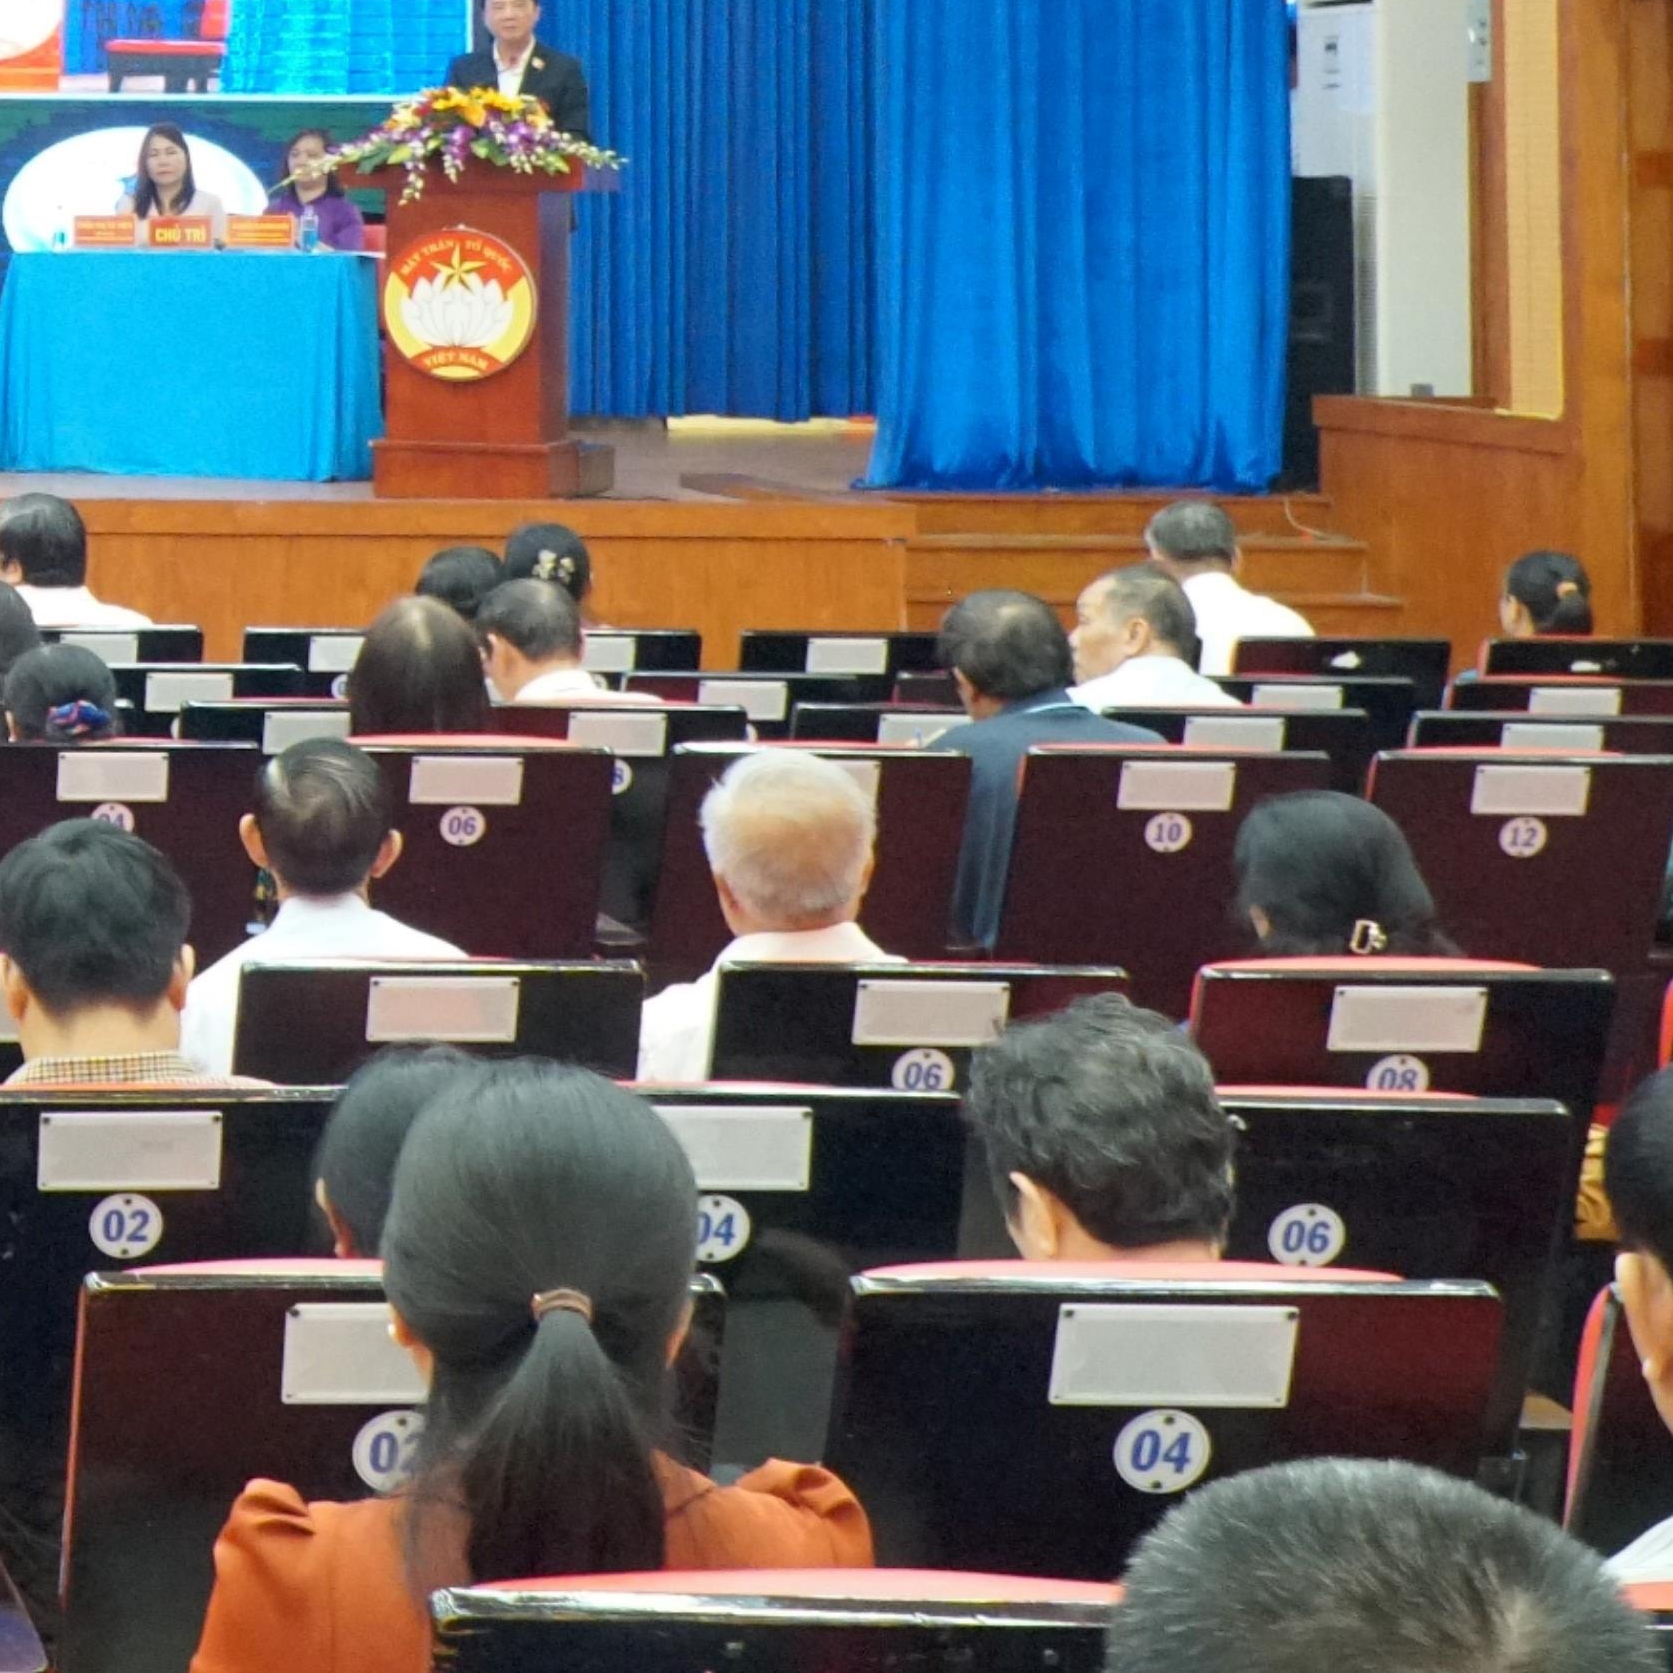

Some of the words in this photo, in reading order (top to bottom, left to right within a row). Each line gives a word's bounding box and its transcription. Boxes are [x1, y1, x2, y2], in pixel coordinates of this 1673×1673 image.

[155, 223, 181, 243] CHỦ
[184, 225, 207, 243] TRÌ
[447, 814, 477, 837] 06
[1152, 821, 1184, 844] 10
[1507, 825, 1539, 849] 12
[904, 1062, 941, 1090] 06
[1377, 1065, 1417, 1091] 08
[102, 1210, 150, 1244] 02
[1282, 1220, 1330, 1253] 06
[1130, 1429, 1192, 1476] 04
